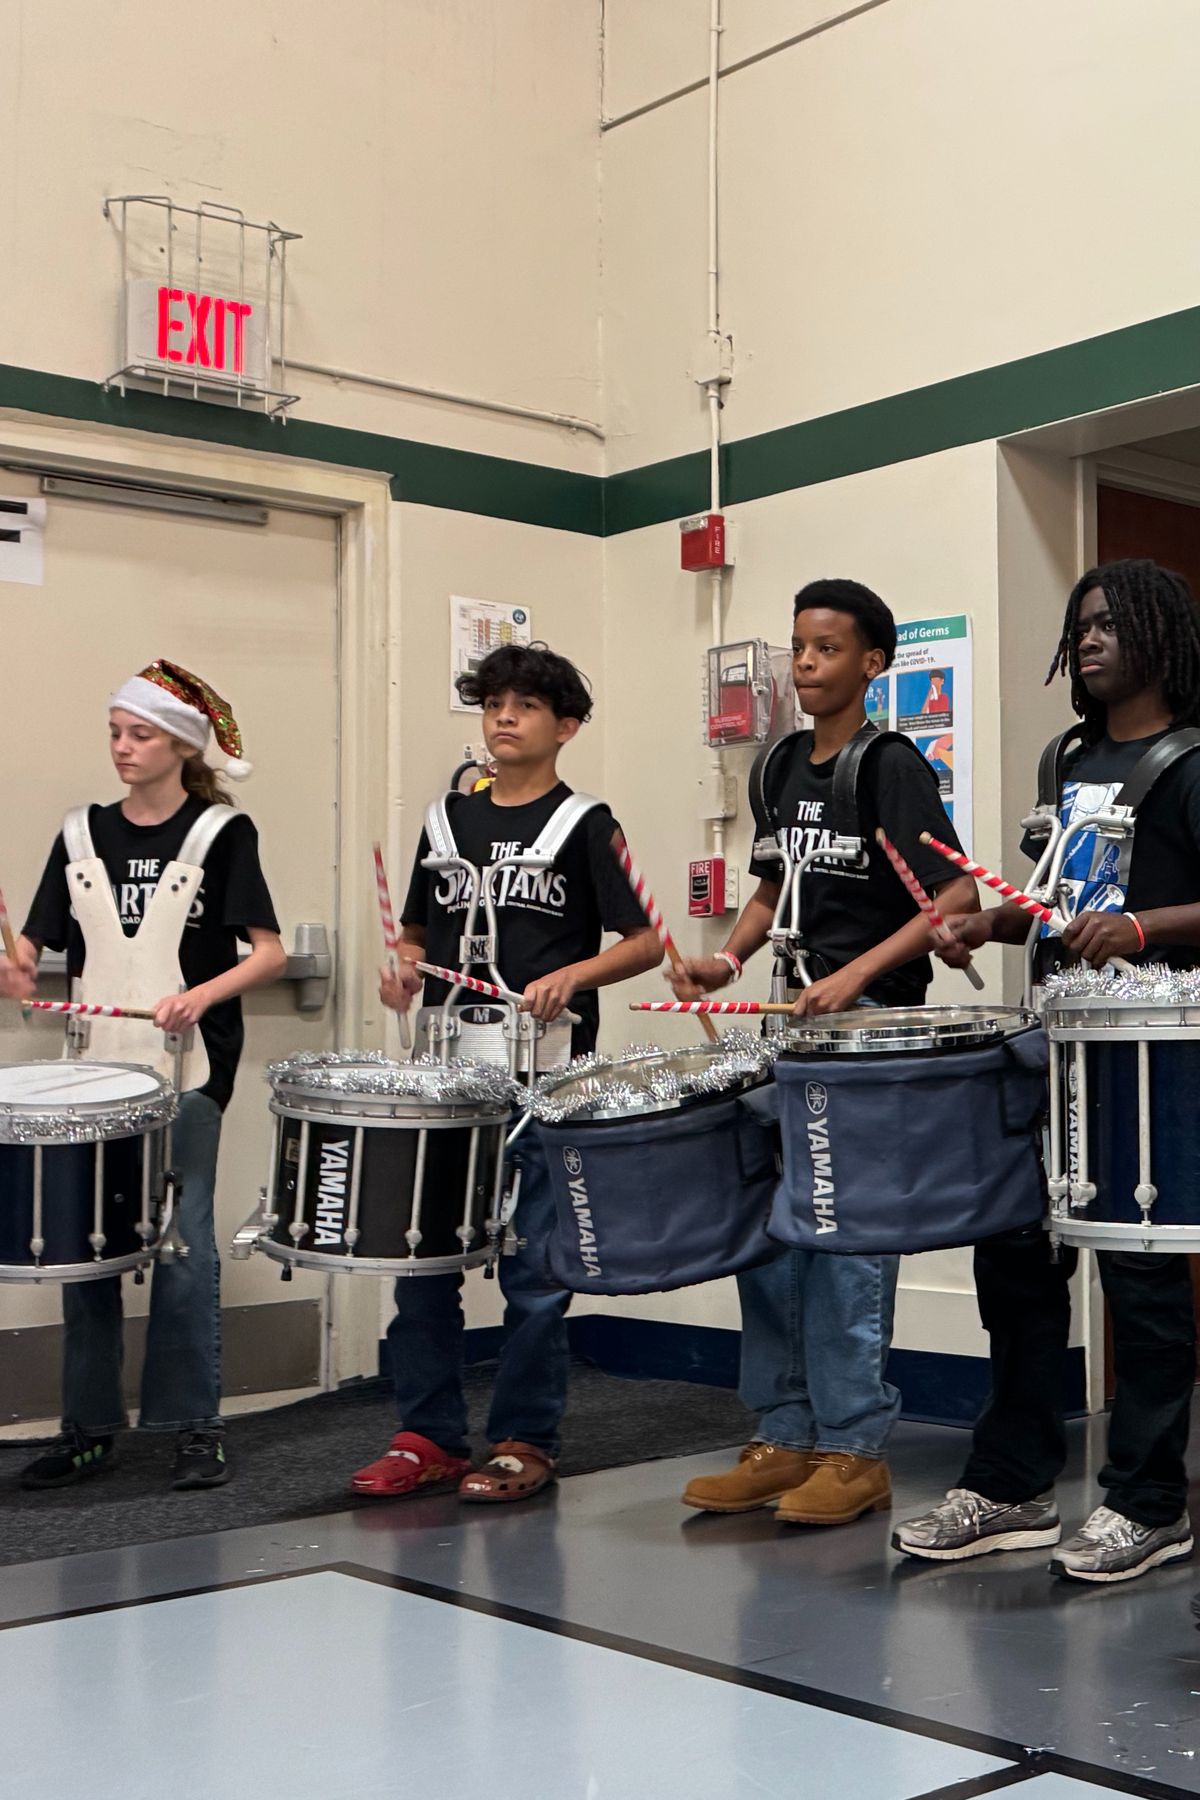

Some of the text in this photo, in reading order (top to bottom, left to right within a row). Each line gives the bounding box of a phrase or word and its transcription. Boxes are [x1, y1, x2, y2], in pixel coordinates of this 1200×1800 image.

[158, 286, 252, 373] EXIT
[908, 628, 918, 640] of
[919, 627, 950, 638] Germs
[797, 801, 824, 821] THE
[490, 842, 521, 860] THE
[127, 859, 160, 878] THE
[691, 862, 710, 875] FIRE
[473, 1008, 490, 1023] M
[807, 1117, 838, 1235] YAMAHA
[314, 1140, 350, 1245] YAMAHA
[568, 1177, 602, 1277] YAMAHA
